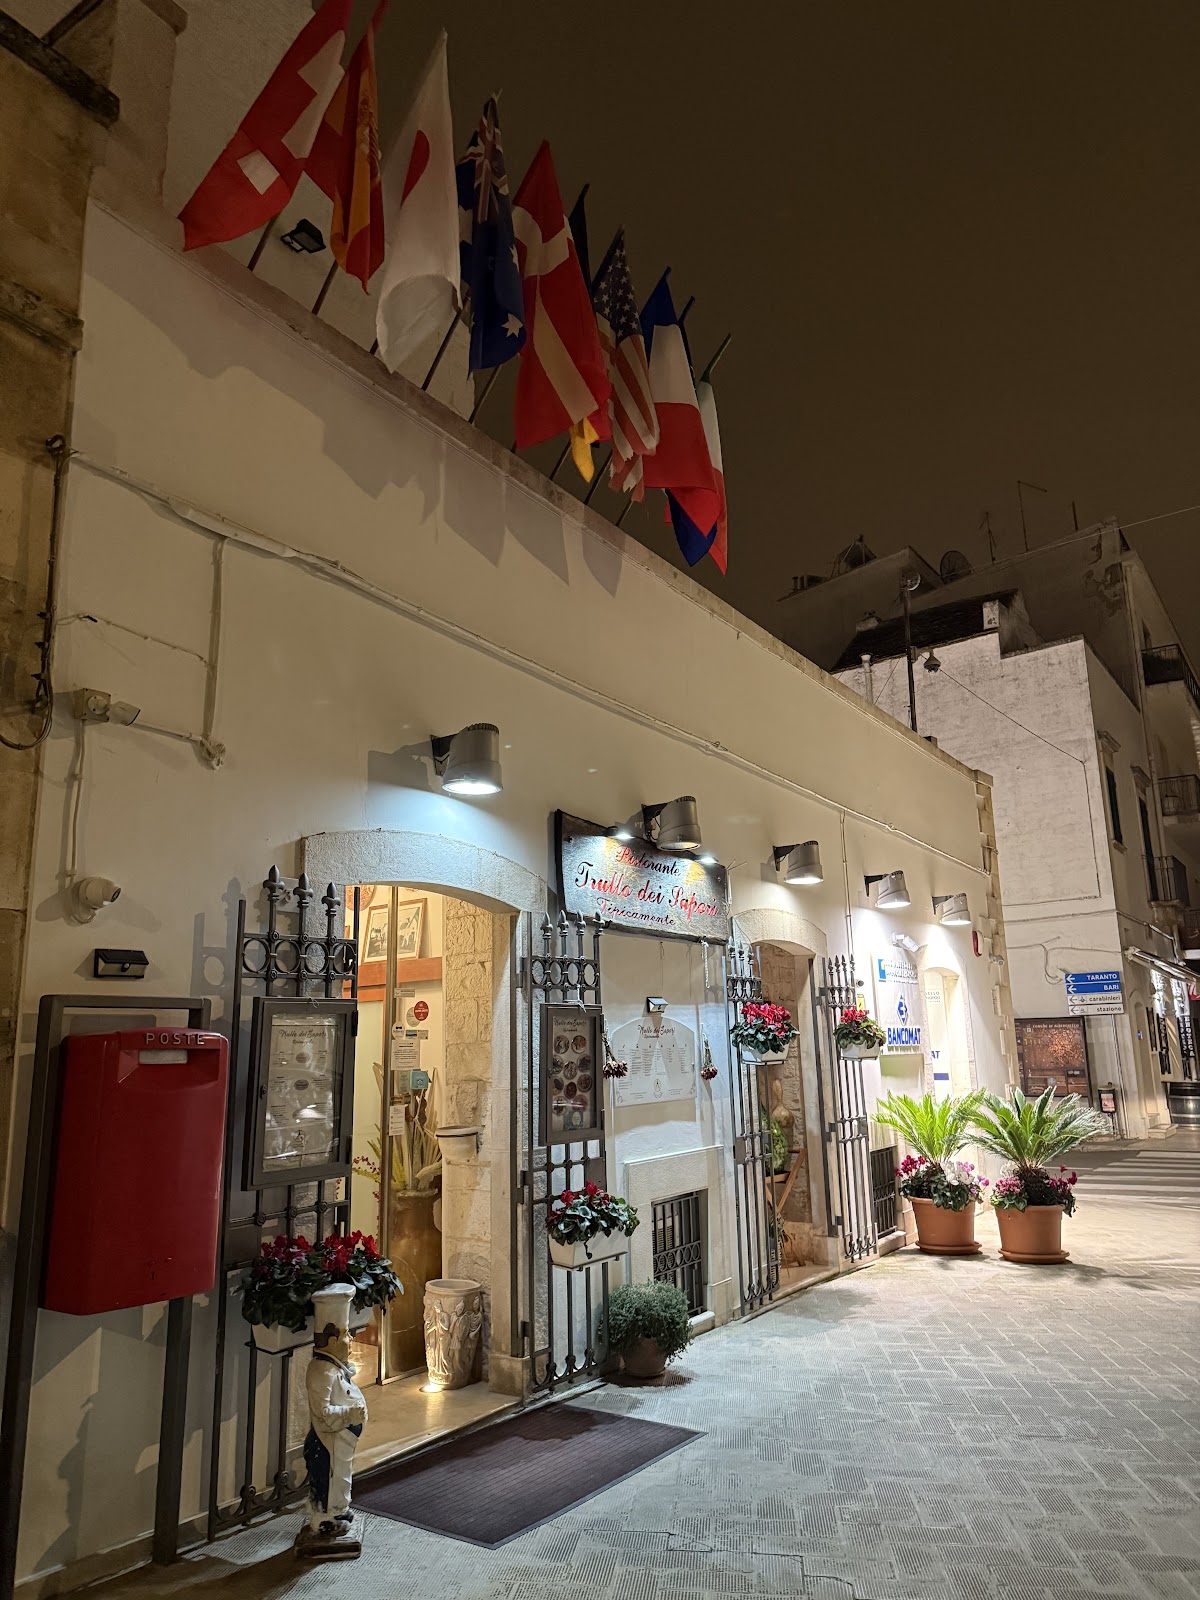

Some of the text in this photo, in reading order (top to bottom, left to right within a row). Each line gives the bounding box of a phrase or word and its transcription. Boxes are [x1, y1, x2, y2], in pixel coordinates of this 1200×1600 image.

[615, 845, 682, 877] Ristorante
[575, 861, 720, 921] Trullo dei Sapori
[596, 897, 677, 926] Tipicamente
[1086, 973, 1118, 981] TARANTO
[145, 1032, 206, 1045] POSTE
[887, 1027, 921, 1045] BANCOMAT
